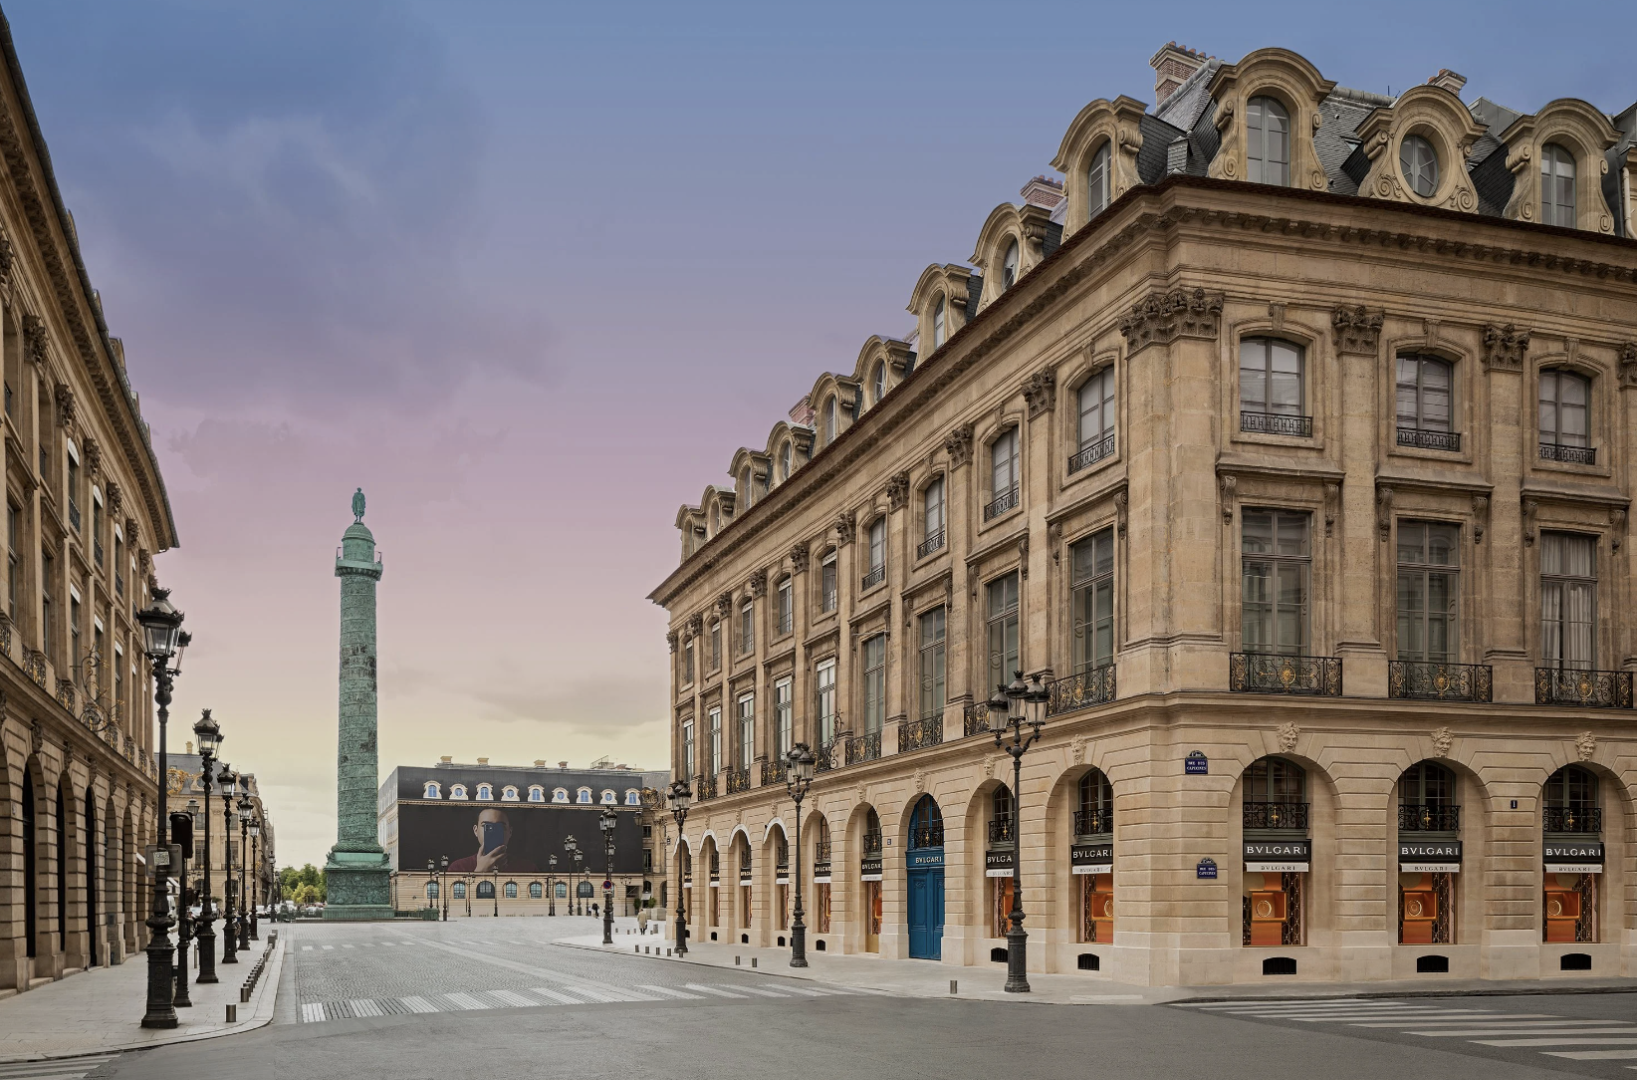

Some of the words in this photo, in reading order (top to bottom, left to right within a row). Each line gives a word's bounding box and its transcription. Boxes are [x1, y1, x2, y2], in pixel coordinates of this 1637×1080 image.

[1073, 850, 1112, 858] BVLGARI
[1246, 846, 1306, 854] BVLGARI
[1546, 848, 1601, 856] BVLGARI
[987, 856, 1012, 864] BVLGA
